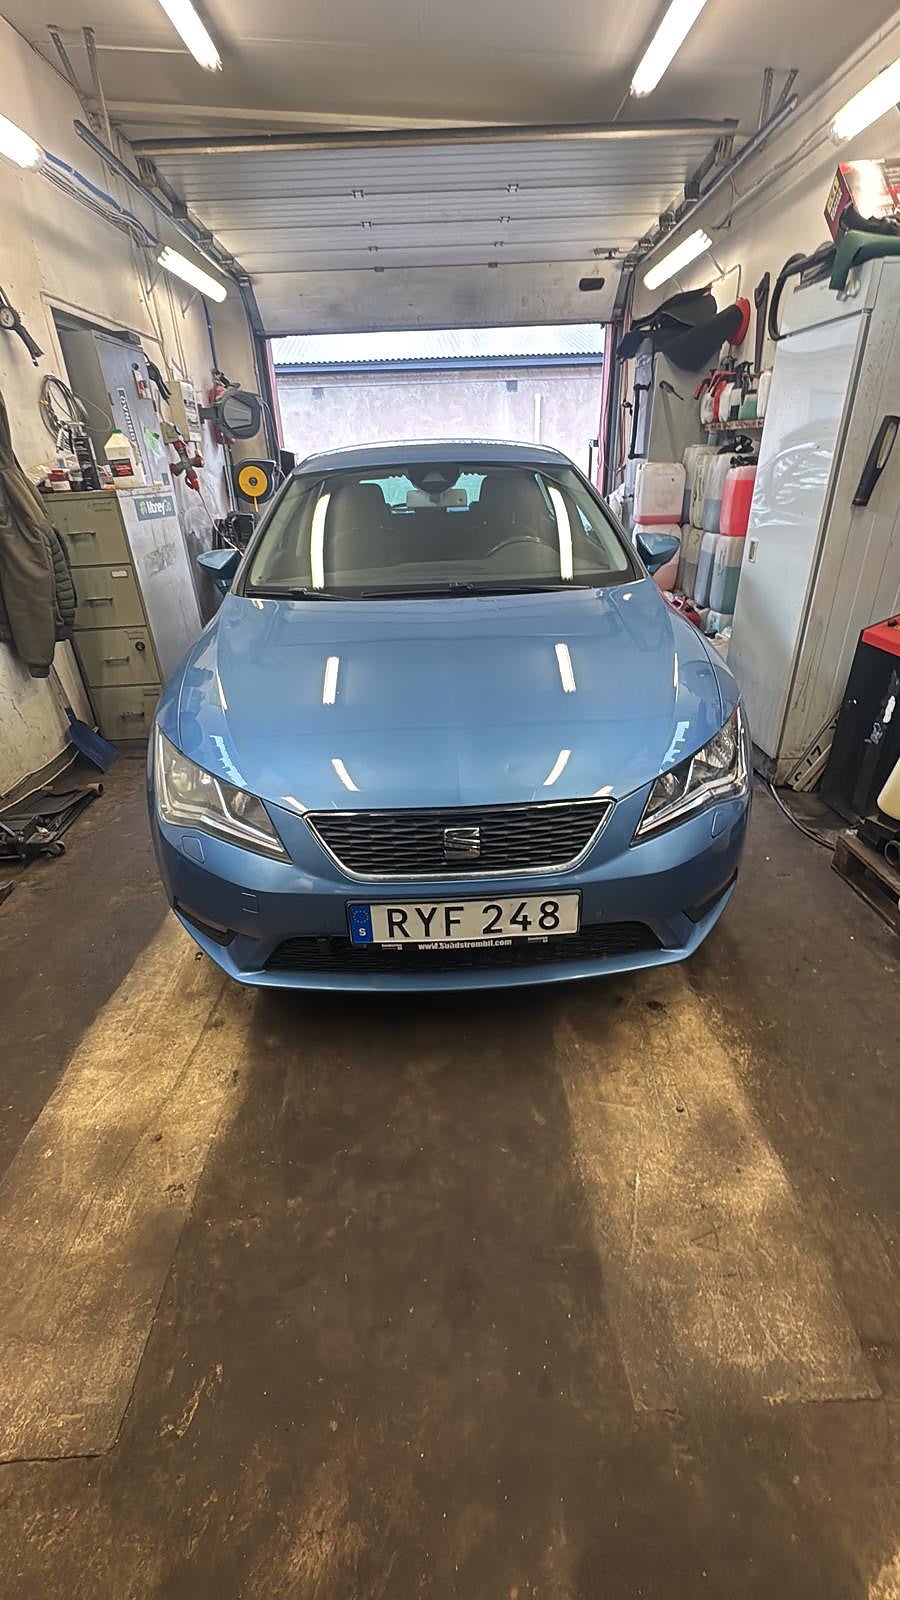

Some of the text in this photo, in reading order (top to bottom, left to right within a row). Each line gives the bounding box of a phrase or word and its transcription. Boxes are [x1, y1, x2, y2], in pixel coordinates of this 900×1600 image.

[387, 901, 560, 938] RYF 248
[359, 928, 366, 936] S
